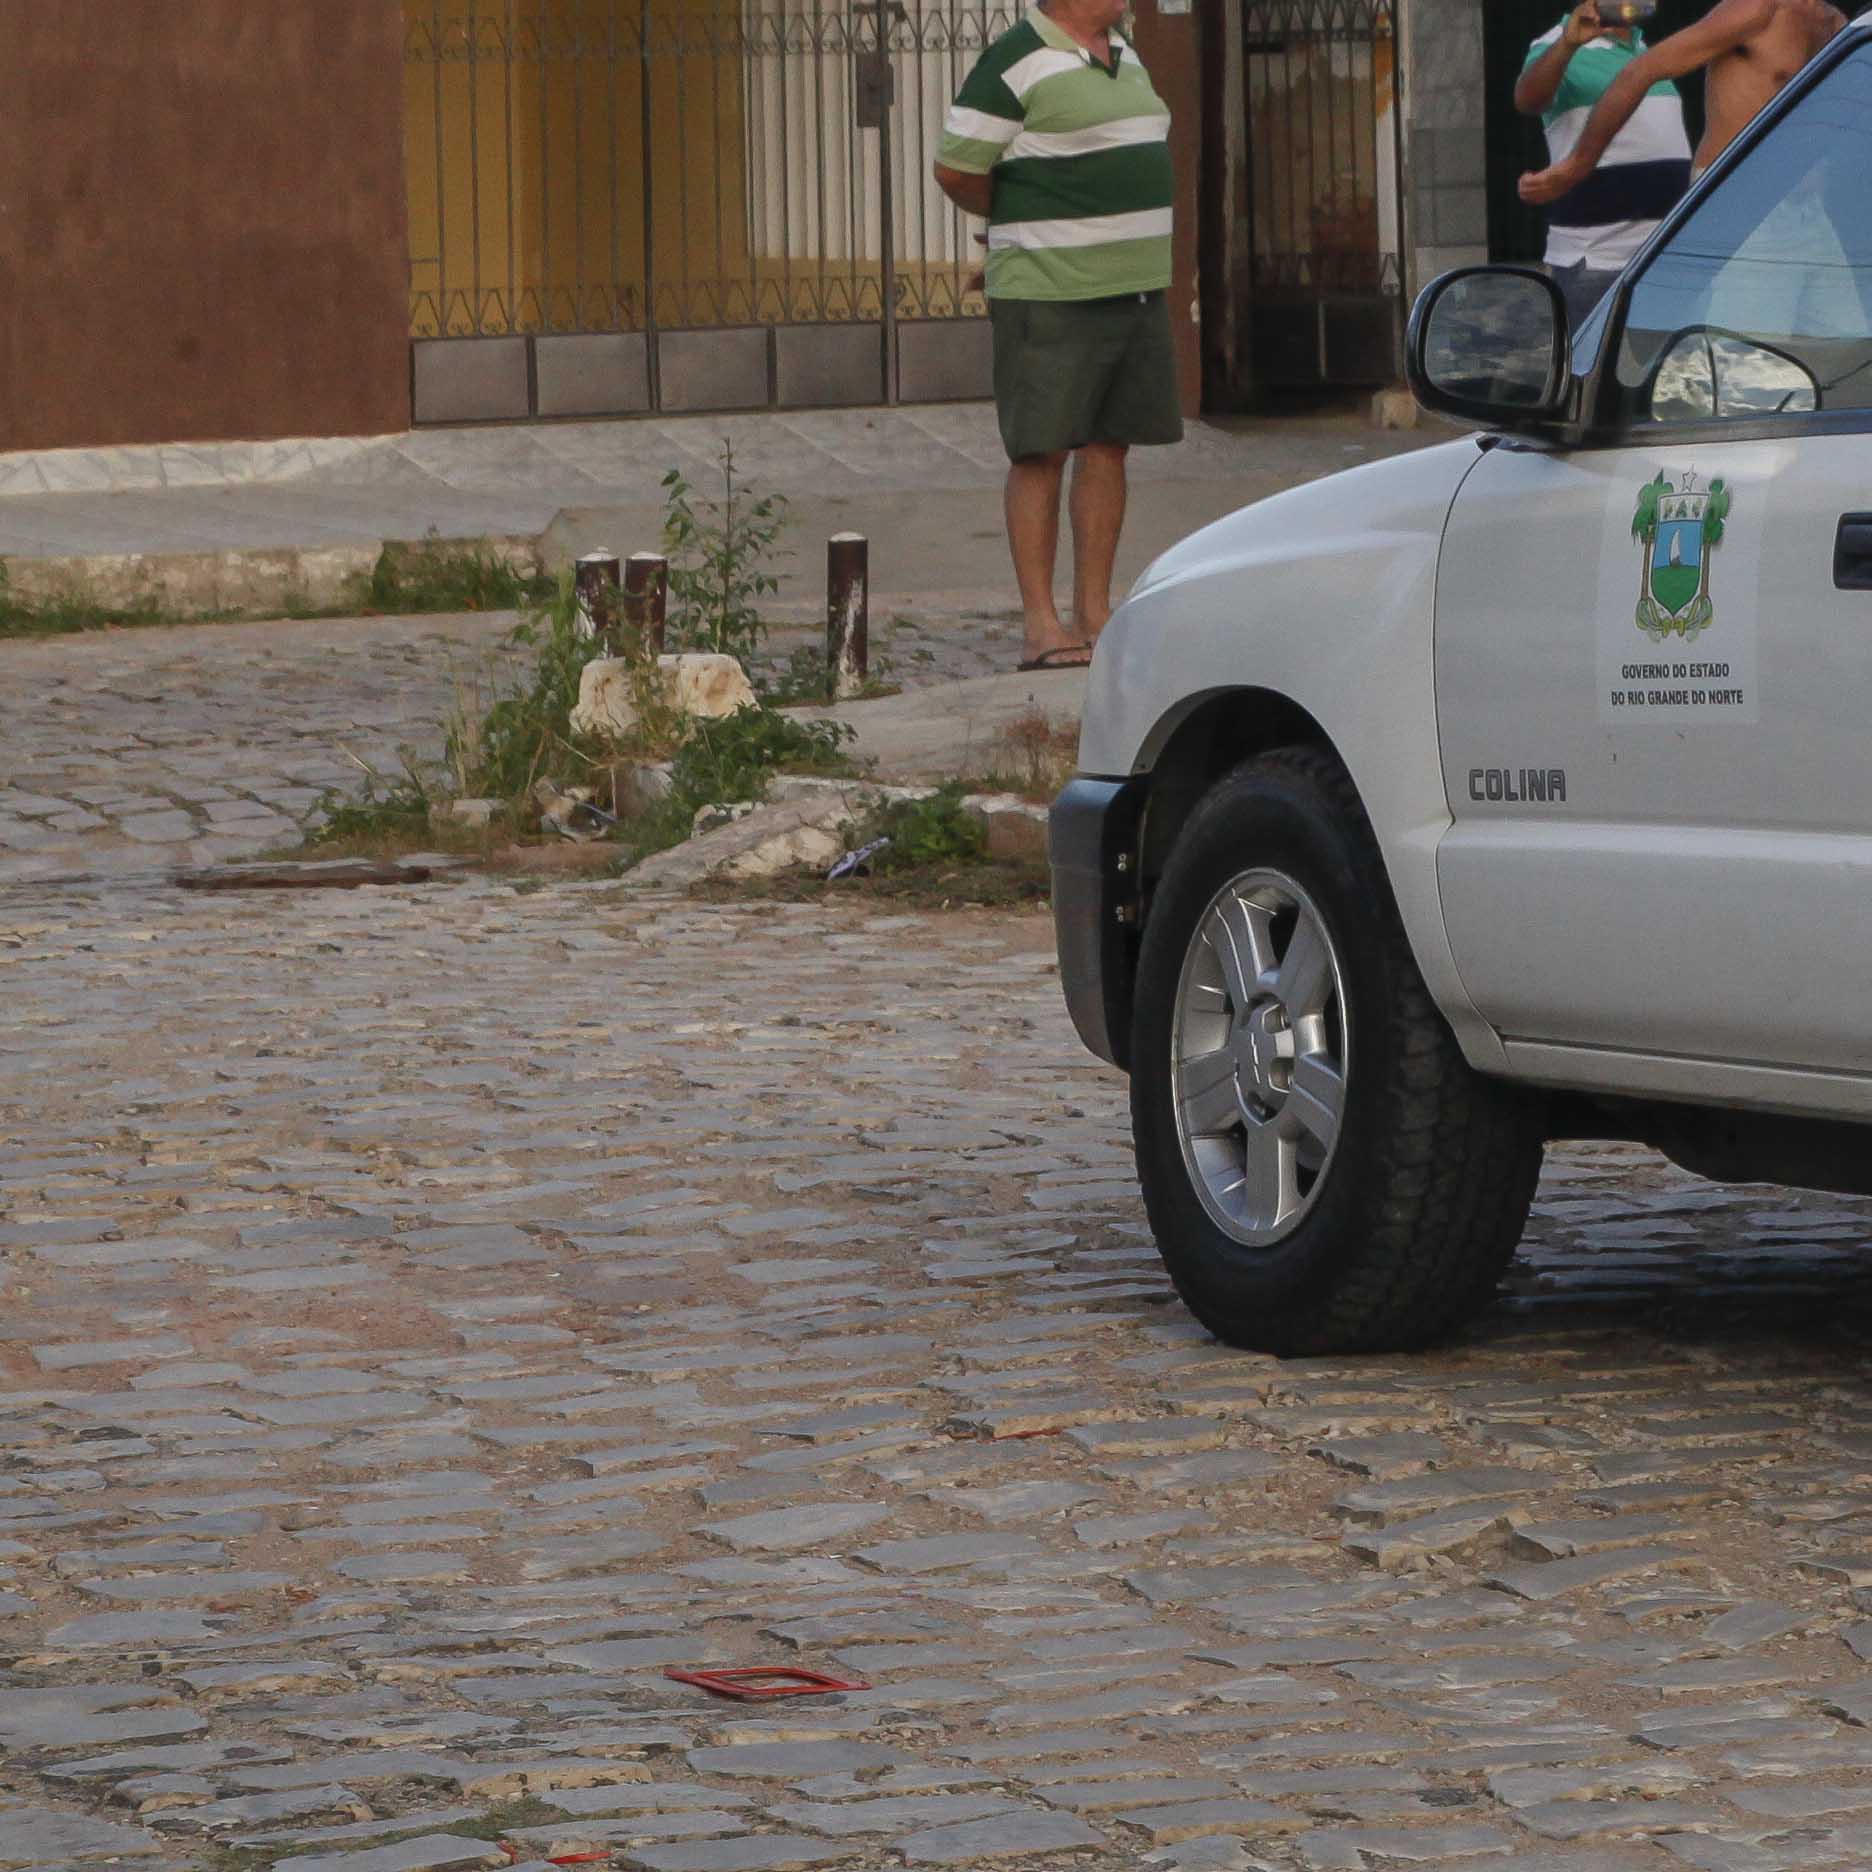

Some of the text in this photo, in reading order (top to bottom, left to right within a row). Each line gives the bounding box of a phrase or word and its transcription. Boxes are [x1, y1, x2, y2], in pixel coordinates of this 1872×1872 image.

[1621, 663, 1730, 679] GOVERNO DO ESTADO
[1611, 689, 1744, 706] DO RIO GRANDE DO NORTE
[1468, 768, 1567, 803] COLINA
